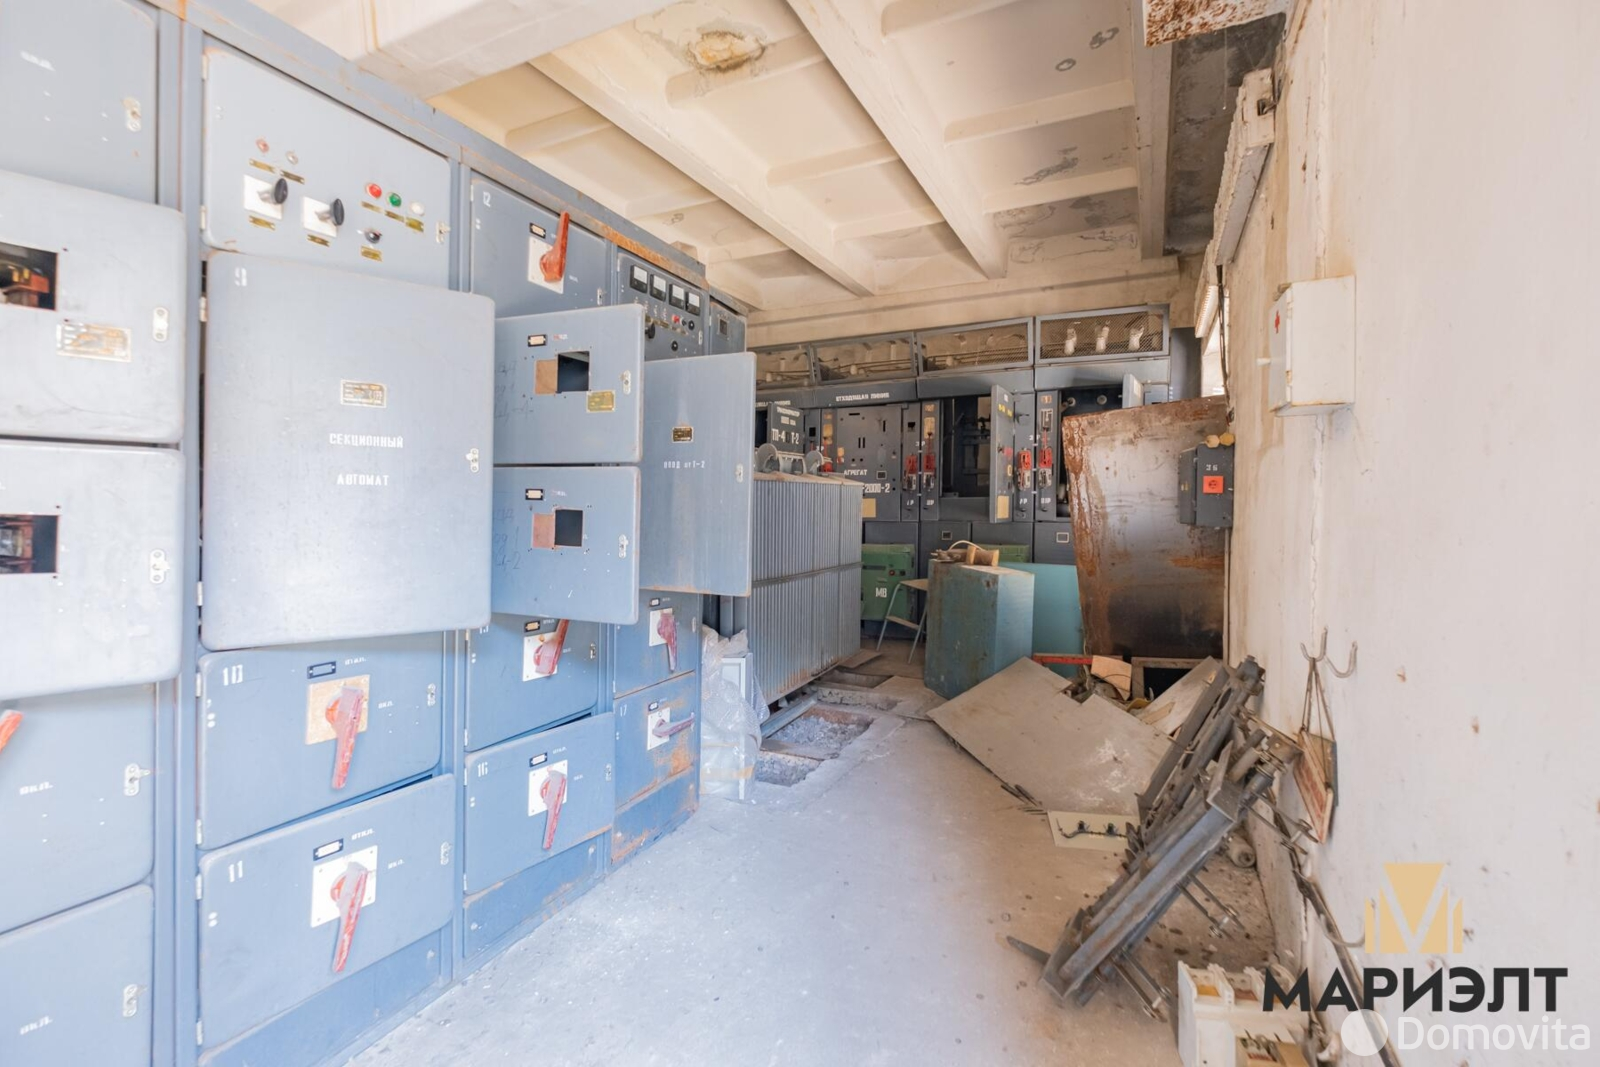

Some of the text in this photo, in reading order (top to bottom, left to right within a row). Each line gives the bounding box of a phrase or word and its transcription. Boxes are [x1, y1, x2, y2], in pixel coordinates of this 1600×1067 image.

[329, 432, 404, 448] СЕКЦИОННЫЙ
[336, 473, 390, 486] АВТОМАТ
[223, 664, 243, 686] 10
[229, 860, 243, 882] 11
